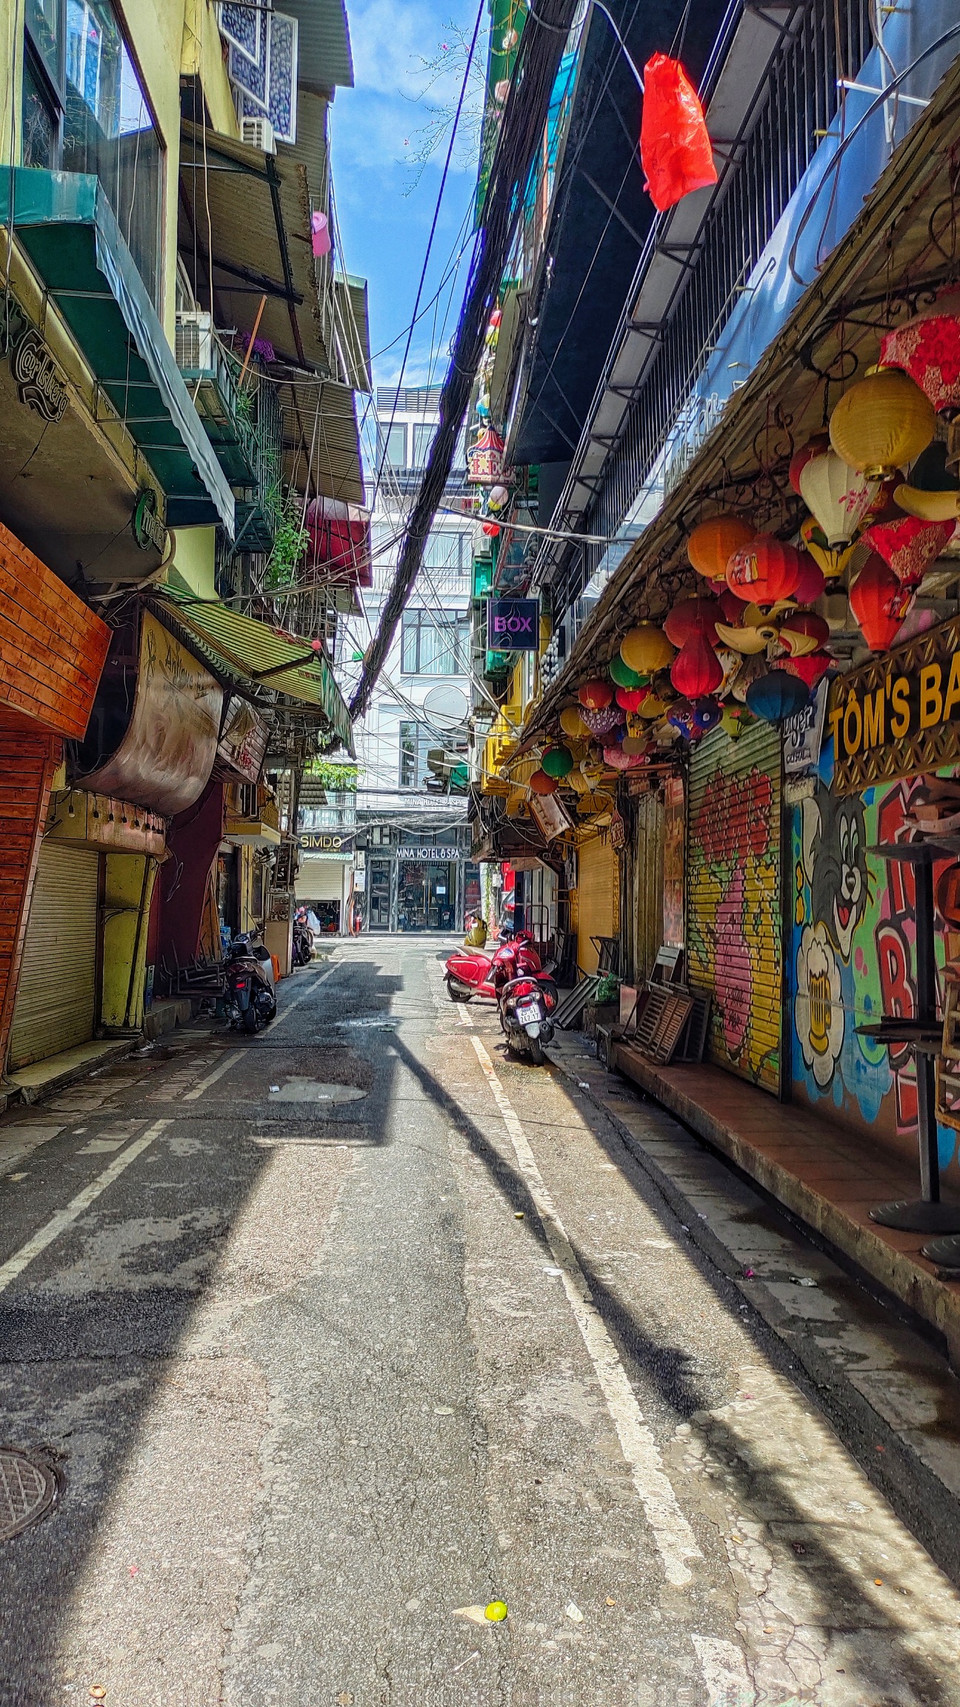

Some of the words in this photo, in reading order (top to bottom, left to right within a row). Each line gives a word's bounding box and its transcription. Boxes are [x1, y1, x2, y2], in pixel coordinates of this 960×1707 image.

[15, 328, 70, 423] Carlsberg
[494, 616, 533, 632] BOX
[828, 673, 911, 761] TÔM'S
[300, 835, 342, 848] SIMDO
[396, 848, 415, 858] MINA
[416, 848, 440, 859] HOTEL
[446, 848, 460, 859] SPA
